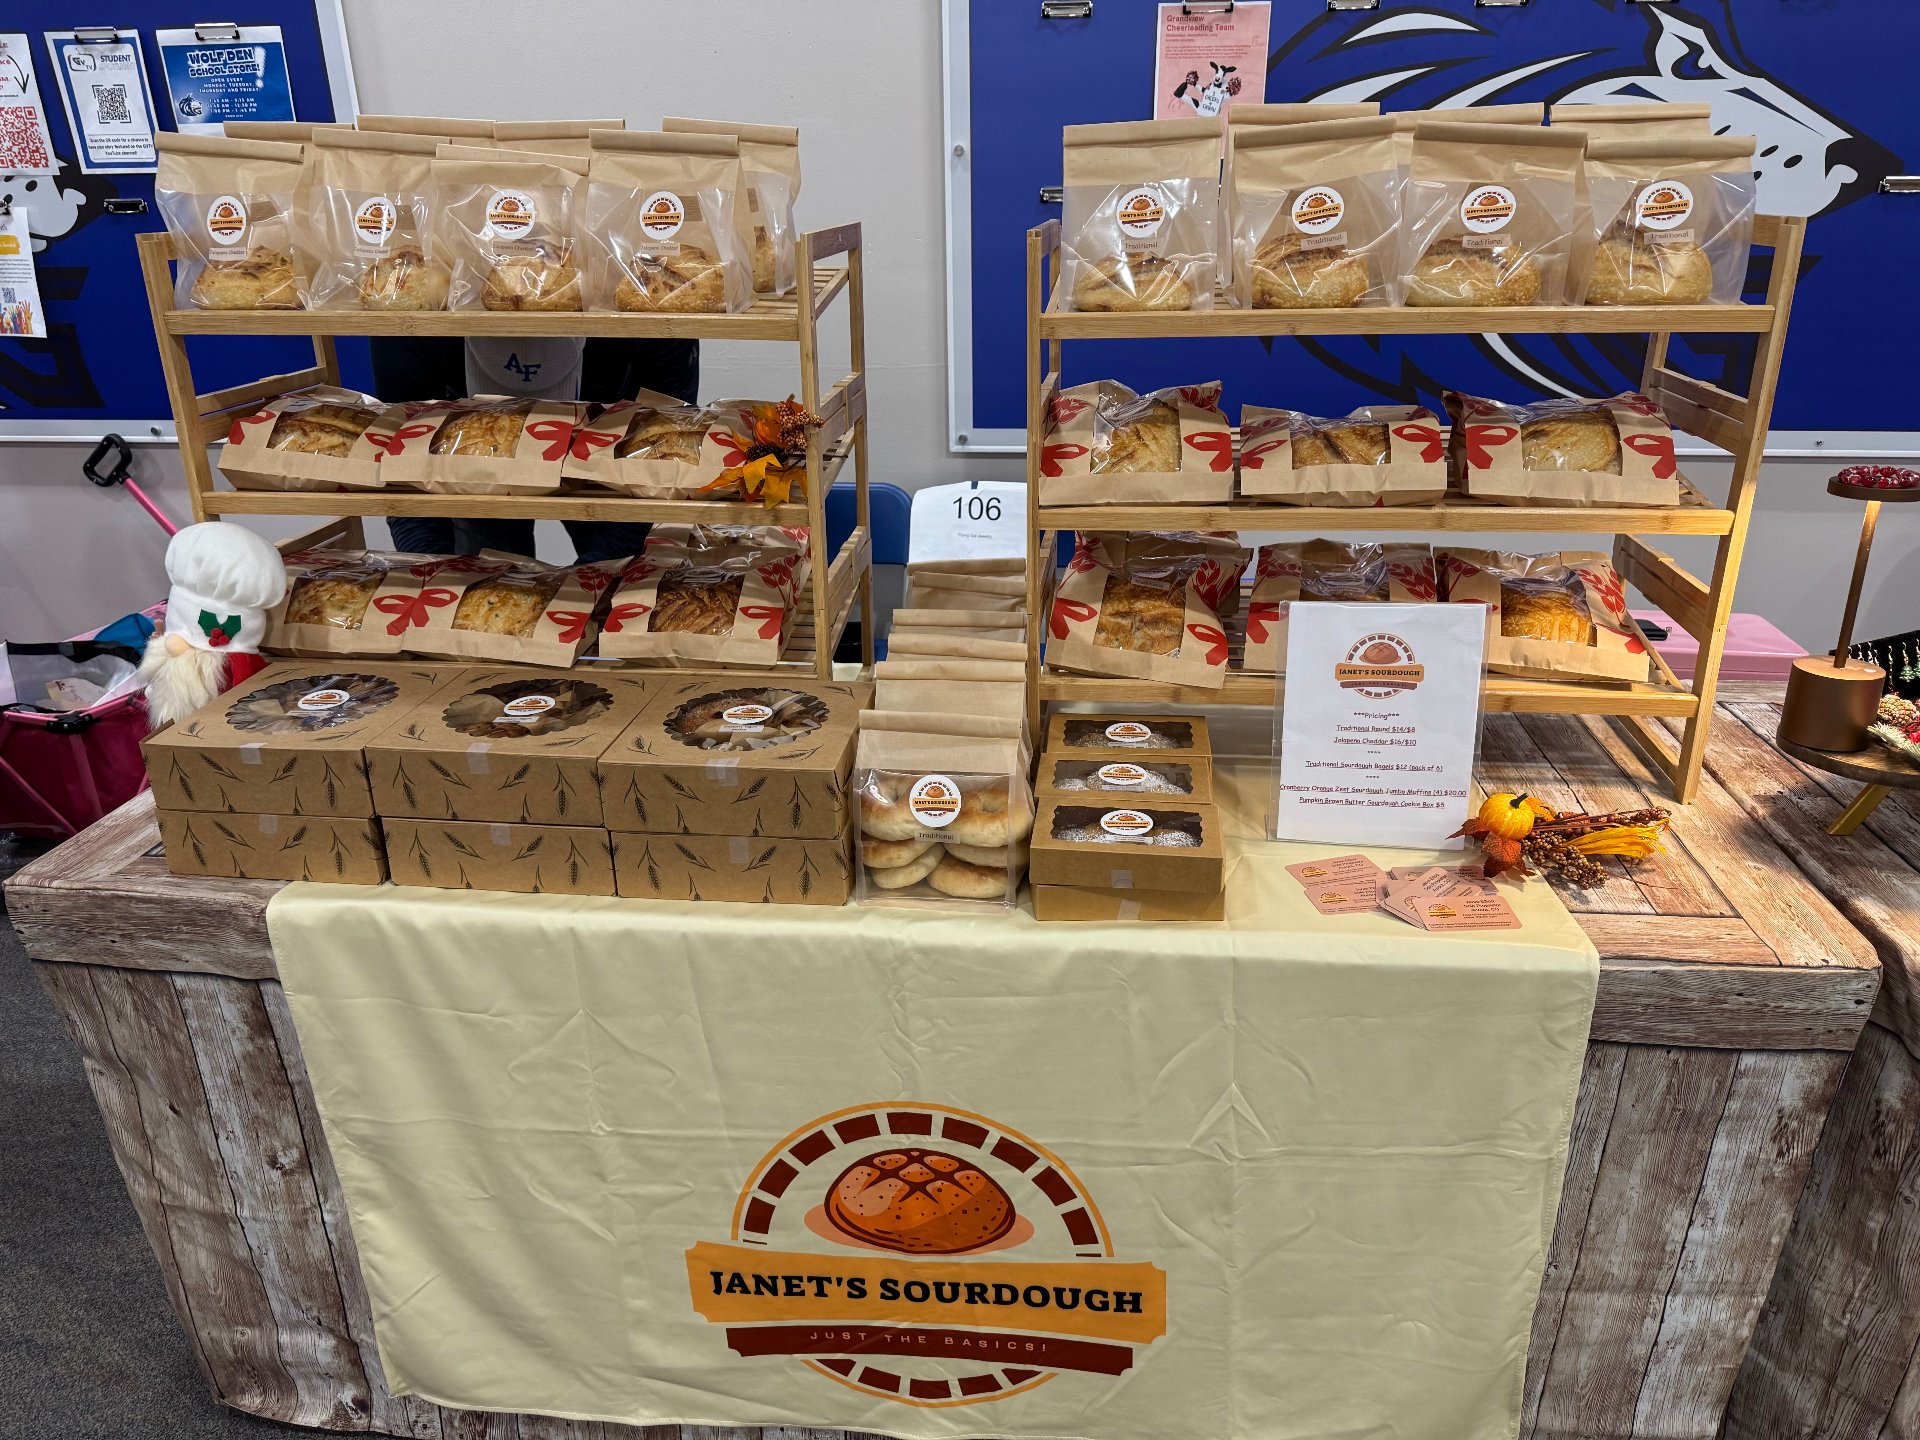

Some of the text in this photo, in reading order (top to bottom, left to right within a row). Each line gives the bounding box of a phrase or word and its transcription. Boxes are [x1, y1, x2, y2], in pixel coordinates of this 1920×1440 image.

[1167, 24, 1213, 32] Cheerleading
[187, 48, 254, 66] WOLF DEN
[189, 65, 227, 77] SCHOOL
[1307, 234, 1343, 245] Traditional
[1650, 231, 1689, 239] Traditional
[1468, 238, 1504, 246] Traditional
[953, 496, 1001, 520] 106
[709, 1271, 1143, 1314] JANET'S SOURDOUGH
[810, 1332, 1046, 1351] JUST THE BASICS!
